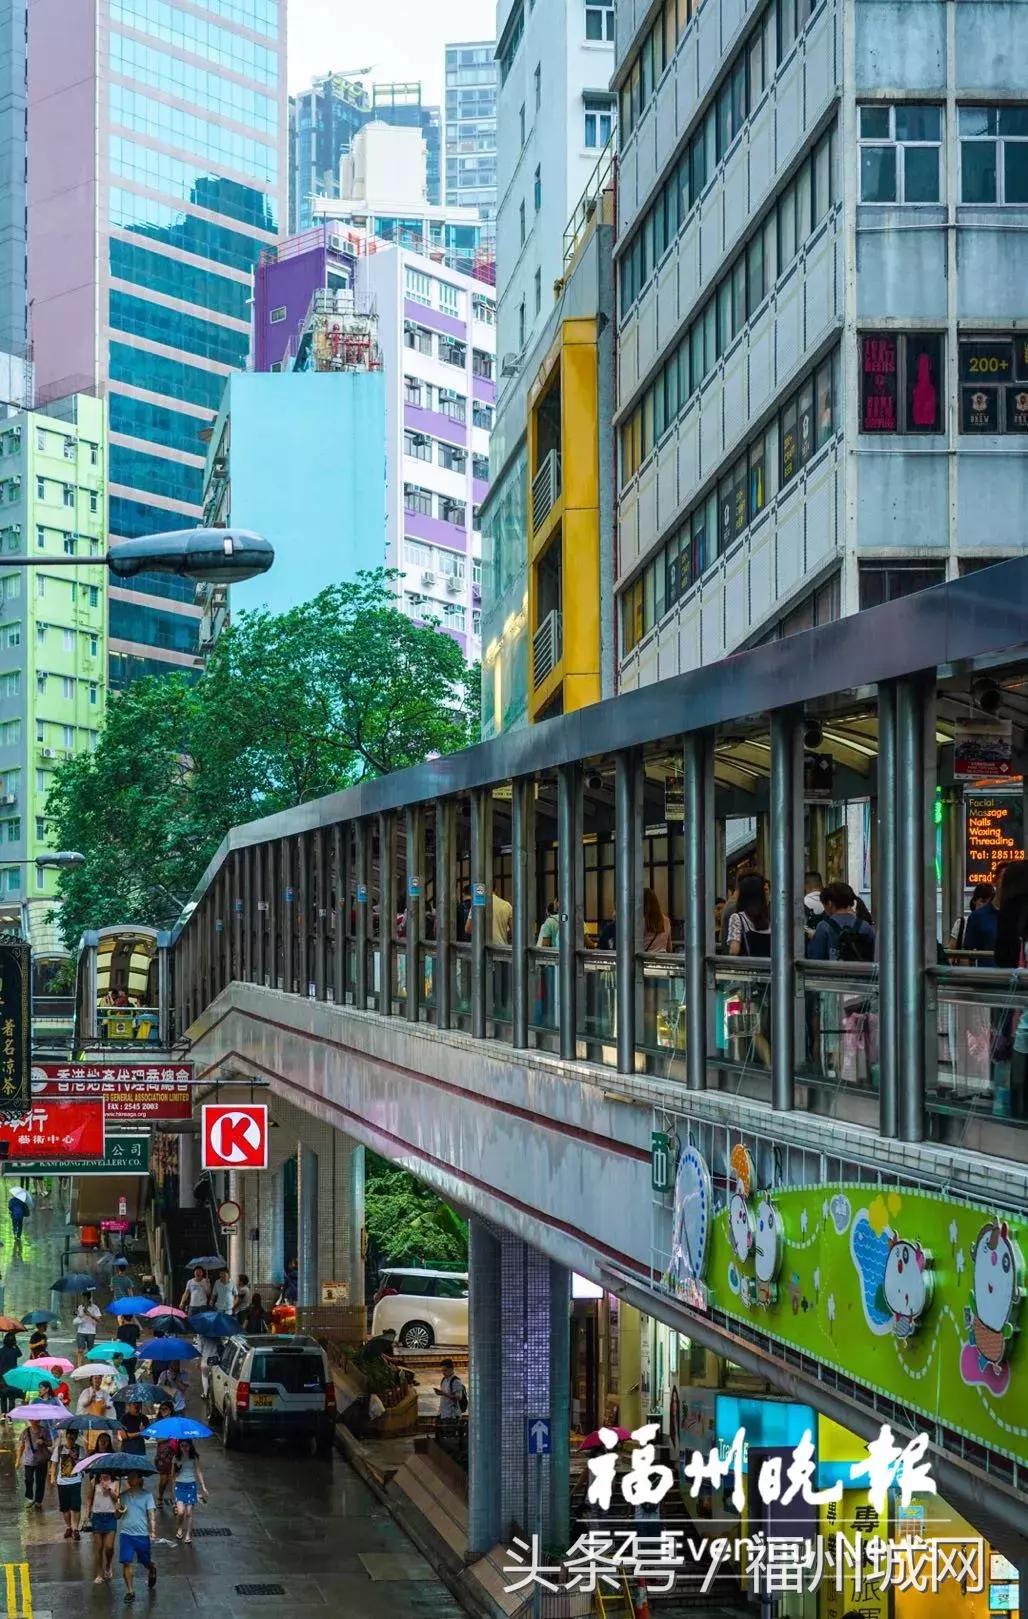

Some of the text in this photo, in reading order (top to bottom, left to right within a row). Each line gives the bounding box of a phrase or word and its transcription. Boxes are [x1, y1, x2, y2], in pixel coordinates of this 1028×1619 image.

[969, 357, 1009, 372] 200+
[969, 799, 995, 807] Facial
[969, 809, 1008, 818] Massage
[969, 818, 991, 827] Nails
[969, 828, 1001, 837] Waxing
[969, 837, 1015, 846] Threading
[110, 1093, 134, 1102] GENERAL
[135, 1093, 168, 1102] ASSOCIATION
[169, 1093, 190, 1102] LIMITED
[81, 1159, 127, 1168] JEWELLERY
[128, 1159, 142, 1167] CO.
